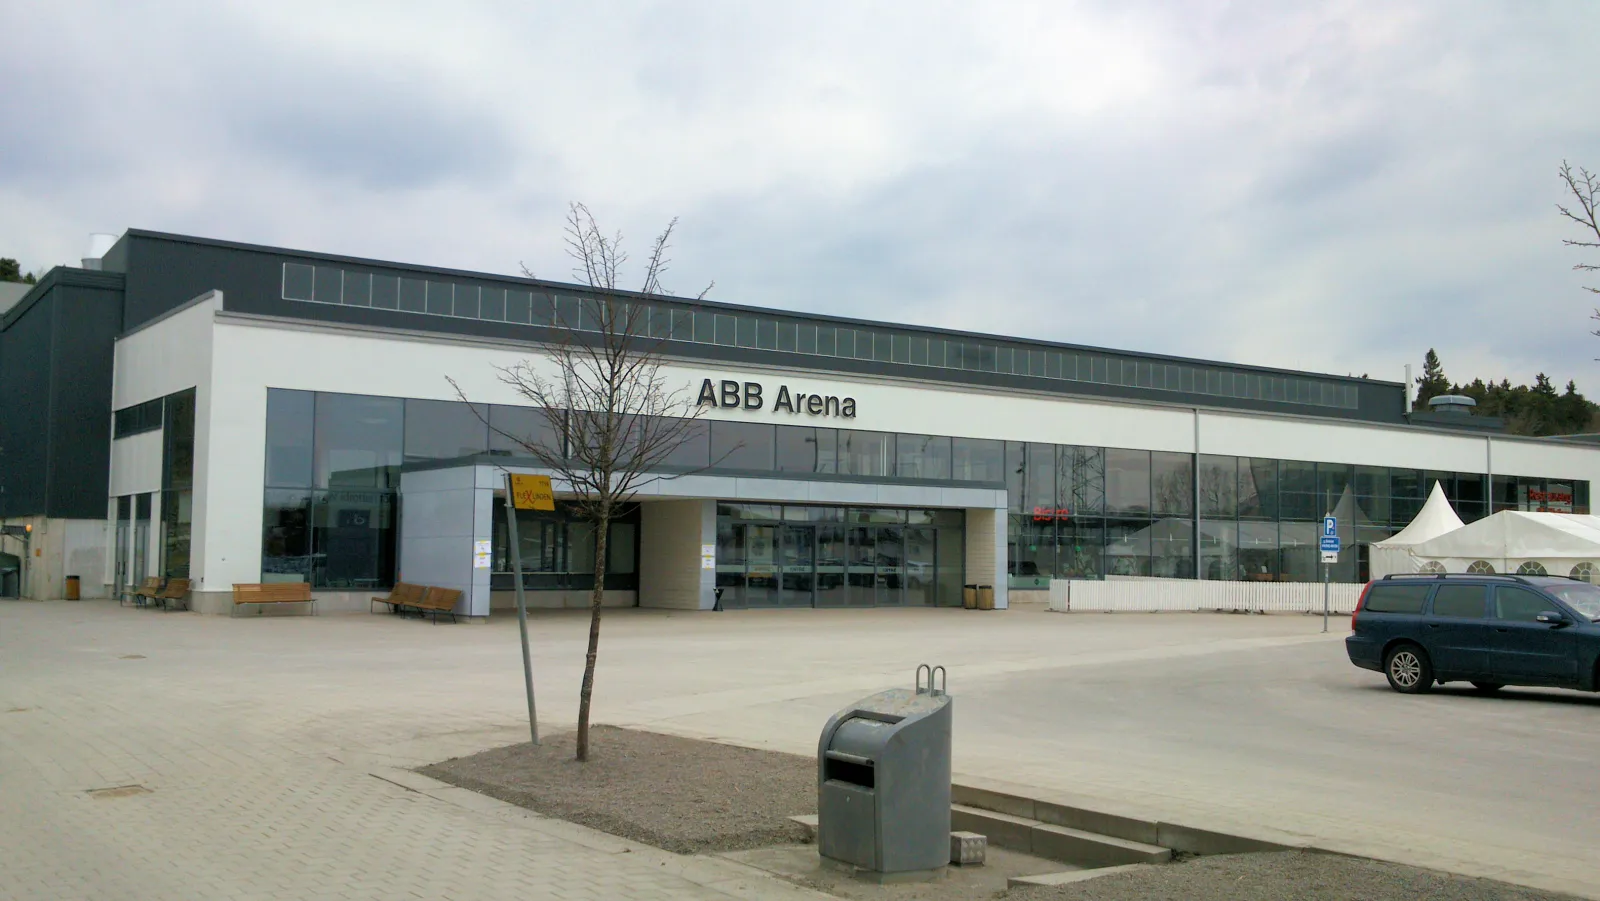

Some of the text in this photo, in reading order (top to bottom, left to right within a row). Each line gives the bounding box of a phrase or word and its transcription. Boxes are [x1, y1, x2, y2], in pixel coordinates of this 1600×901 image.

[696, 378, 856, 417] ABB Arena
[1326, 519, 1334, 535] P
